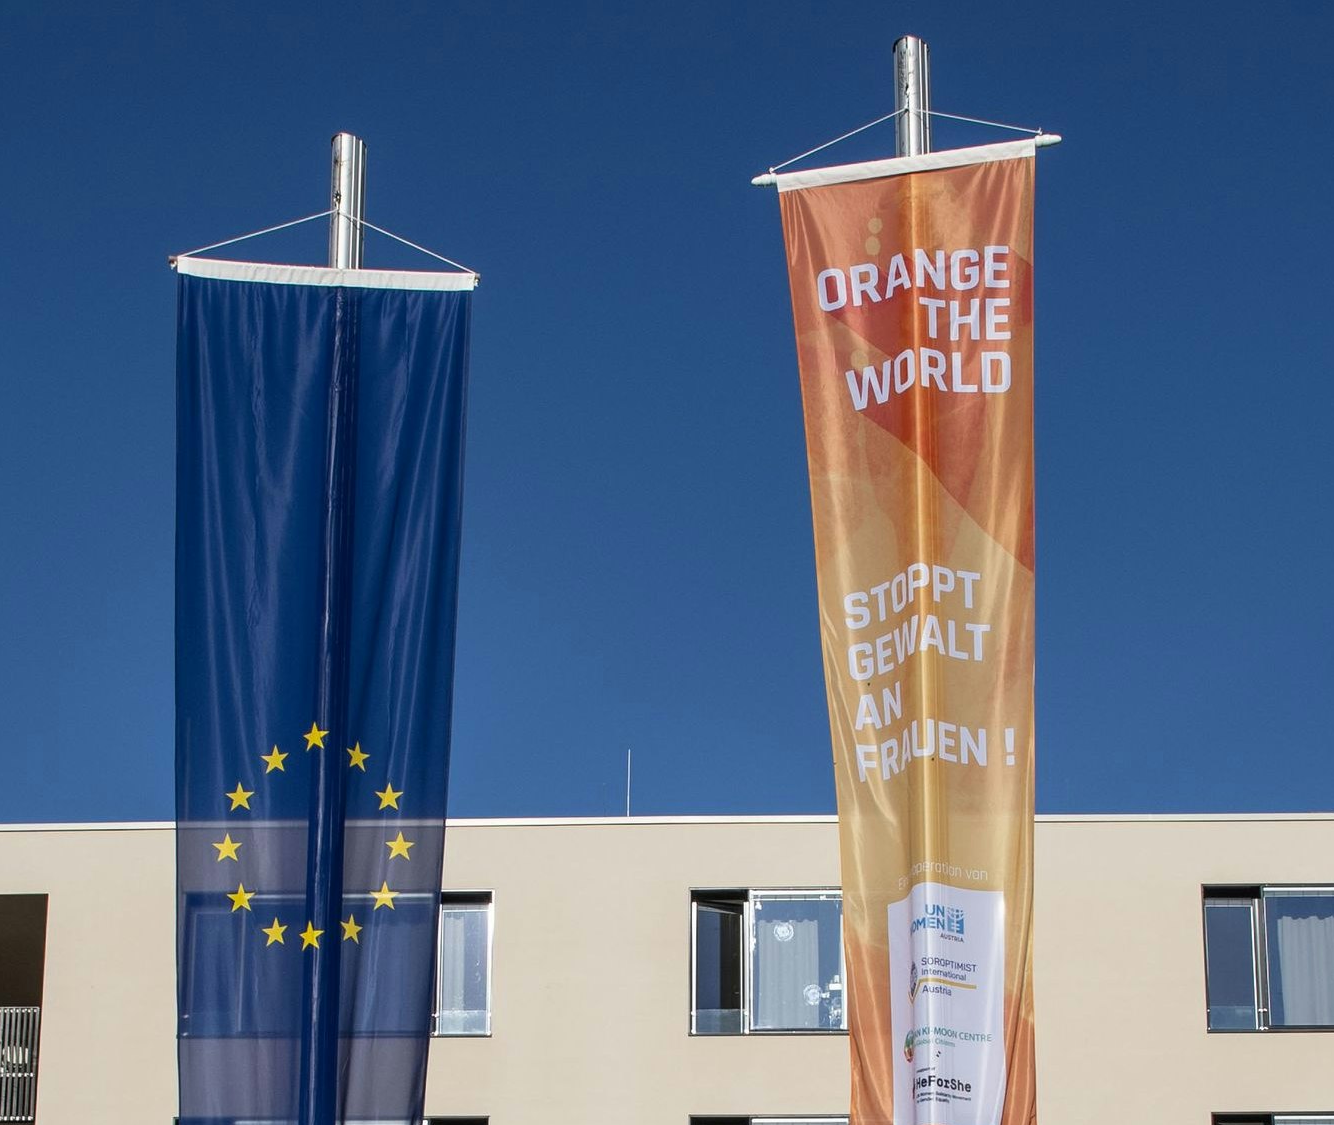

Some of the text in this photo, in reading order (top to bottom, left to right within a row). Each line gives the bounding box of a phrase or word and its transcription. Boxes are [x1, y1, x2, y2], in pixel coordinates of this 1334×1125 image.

[816, 244, 1011, 313] ORANGE
[919, 296, 1012, 341] THE
[845, 347, 1012, 411] WORLD
[843, 562, 981, 631] STOPPT
[846, 613, 991, 682] GEWALT
[854, 681, 903, 731] AN
[854, 725, 988, 783] FRAUEN
[925, 904, 945, 918] UN
[910, 917, 945, 936] OMEN
[939, 932, 964, 943] AUSTRIA
[921, 957, 976, 973] SOROPTIMIST
[921, 968, 967, 981] International
[922, 985, 952, 997] Austria
[958, 1031, 993, 1043] CENTRE
[915, 1075, 972, 1093] HeForShe
